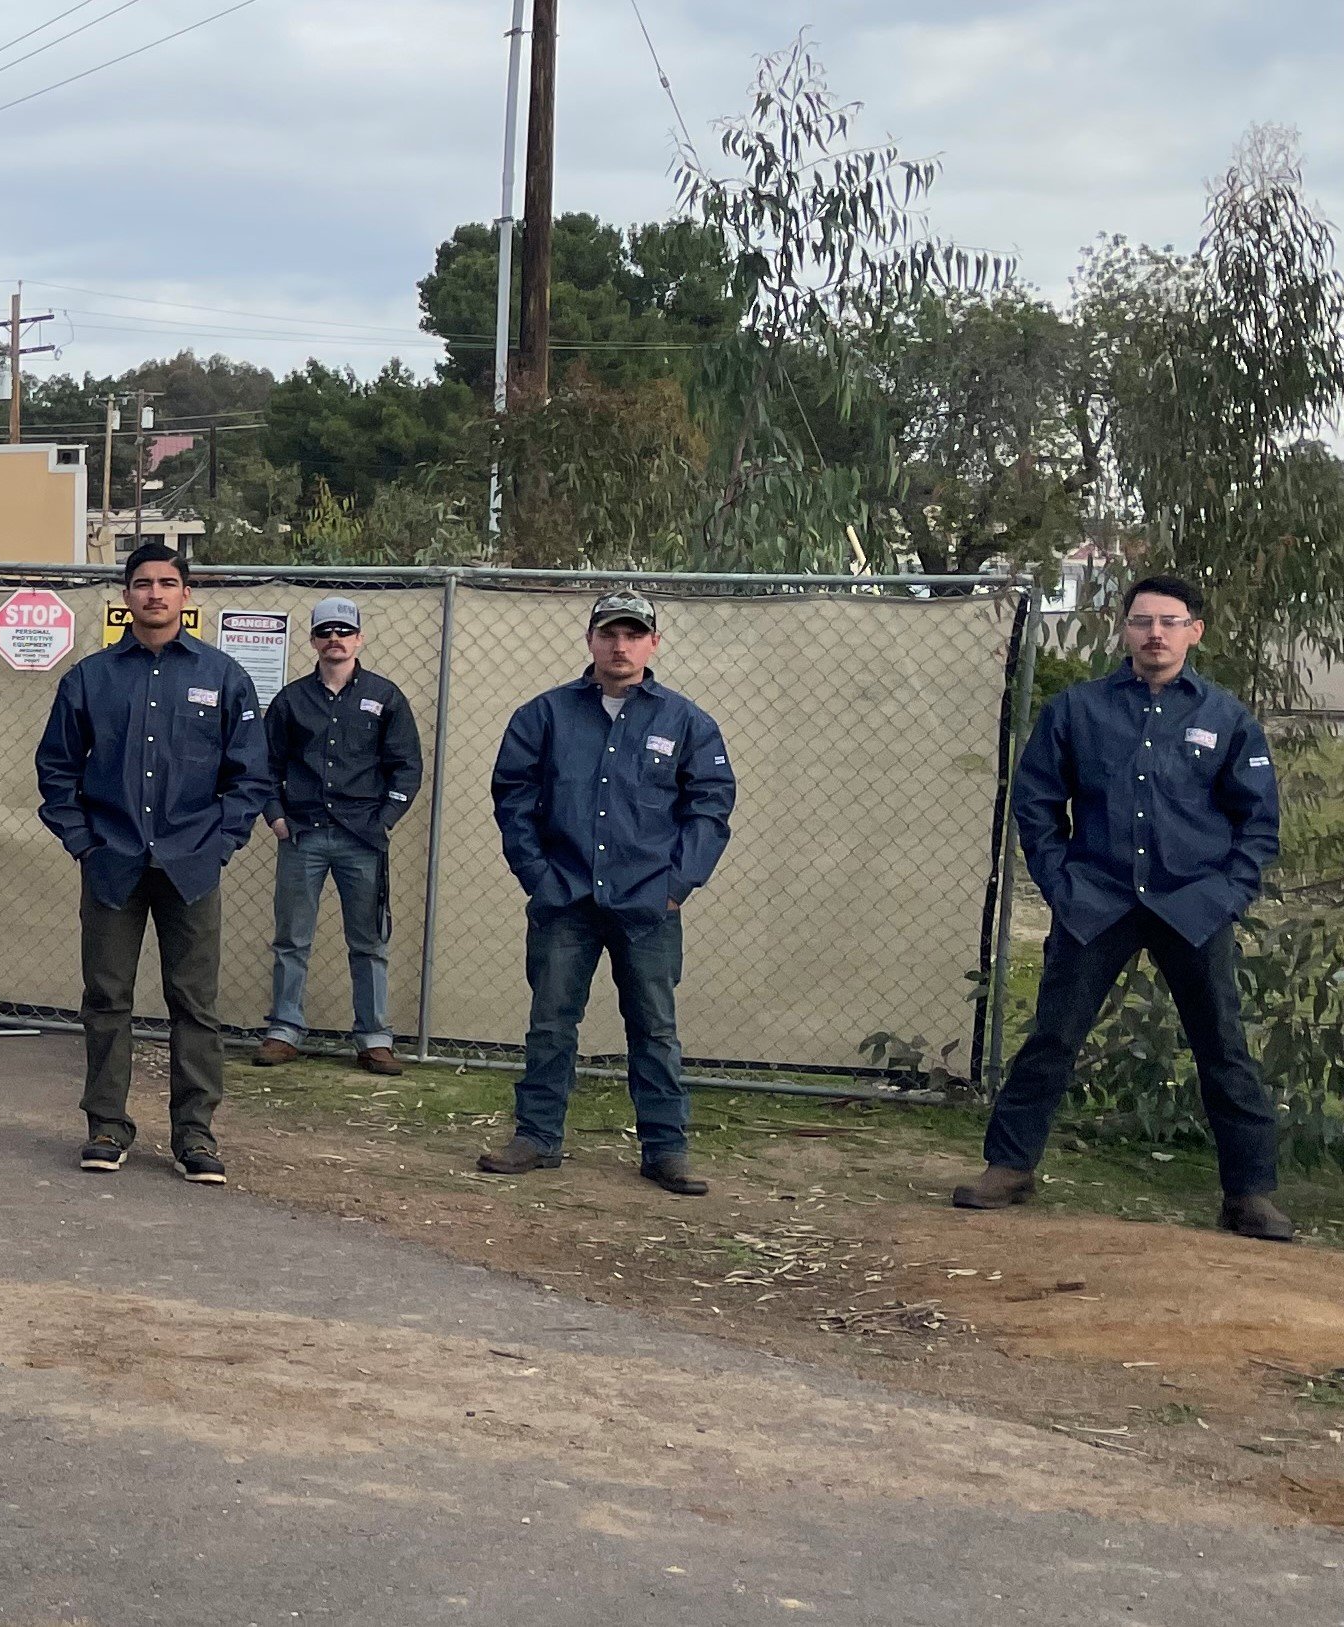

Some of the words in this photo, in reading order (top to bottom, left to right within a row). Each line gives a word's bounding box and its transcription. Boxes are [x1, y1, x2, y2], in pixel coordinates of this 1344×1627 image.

[5, 604, 63, 625] STOP
[231, 618, 278, 629] DANGER
[225, 634, 284, 645] WELDING
